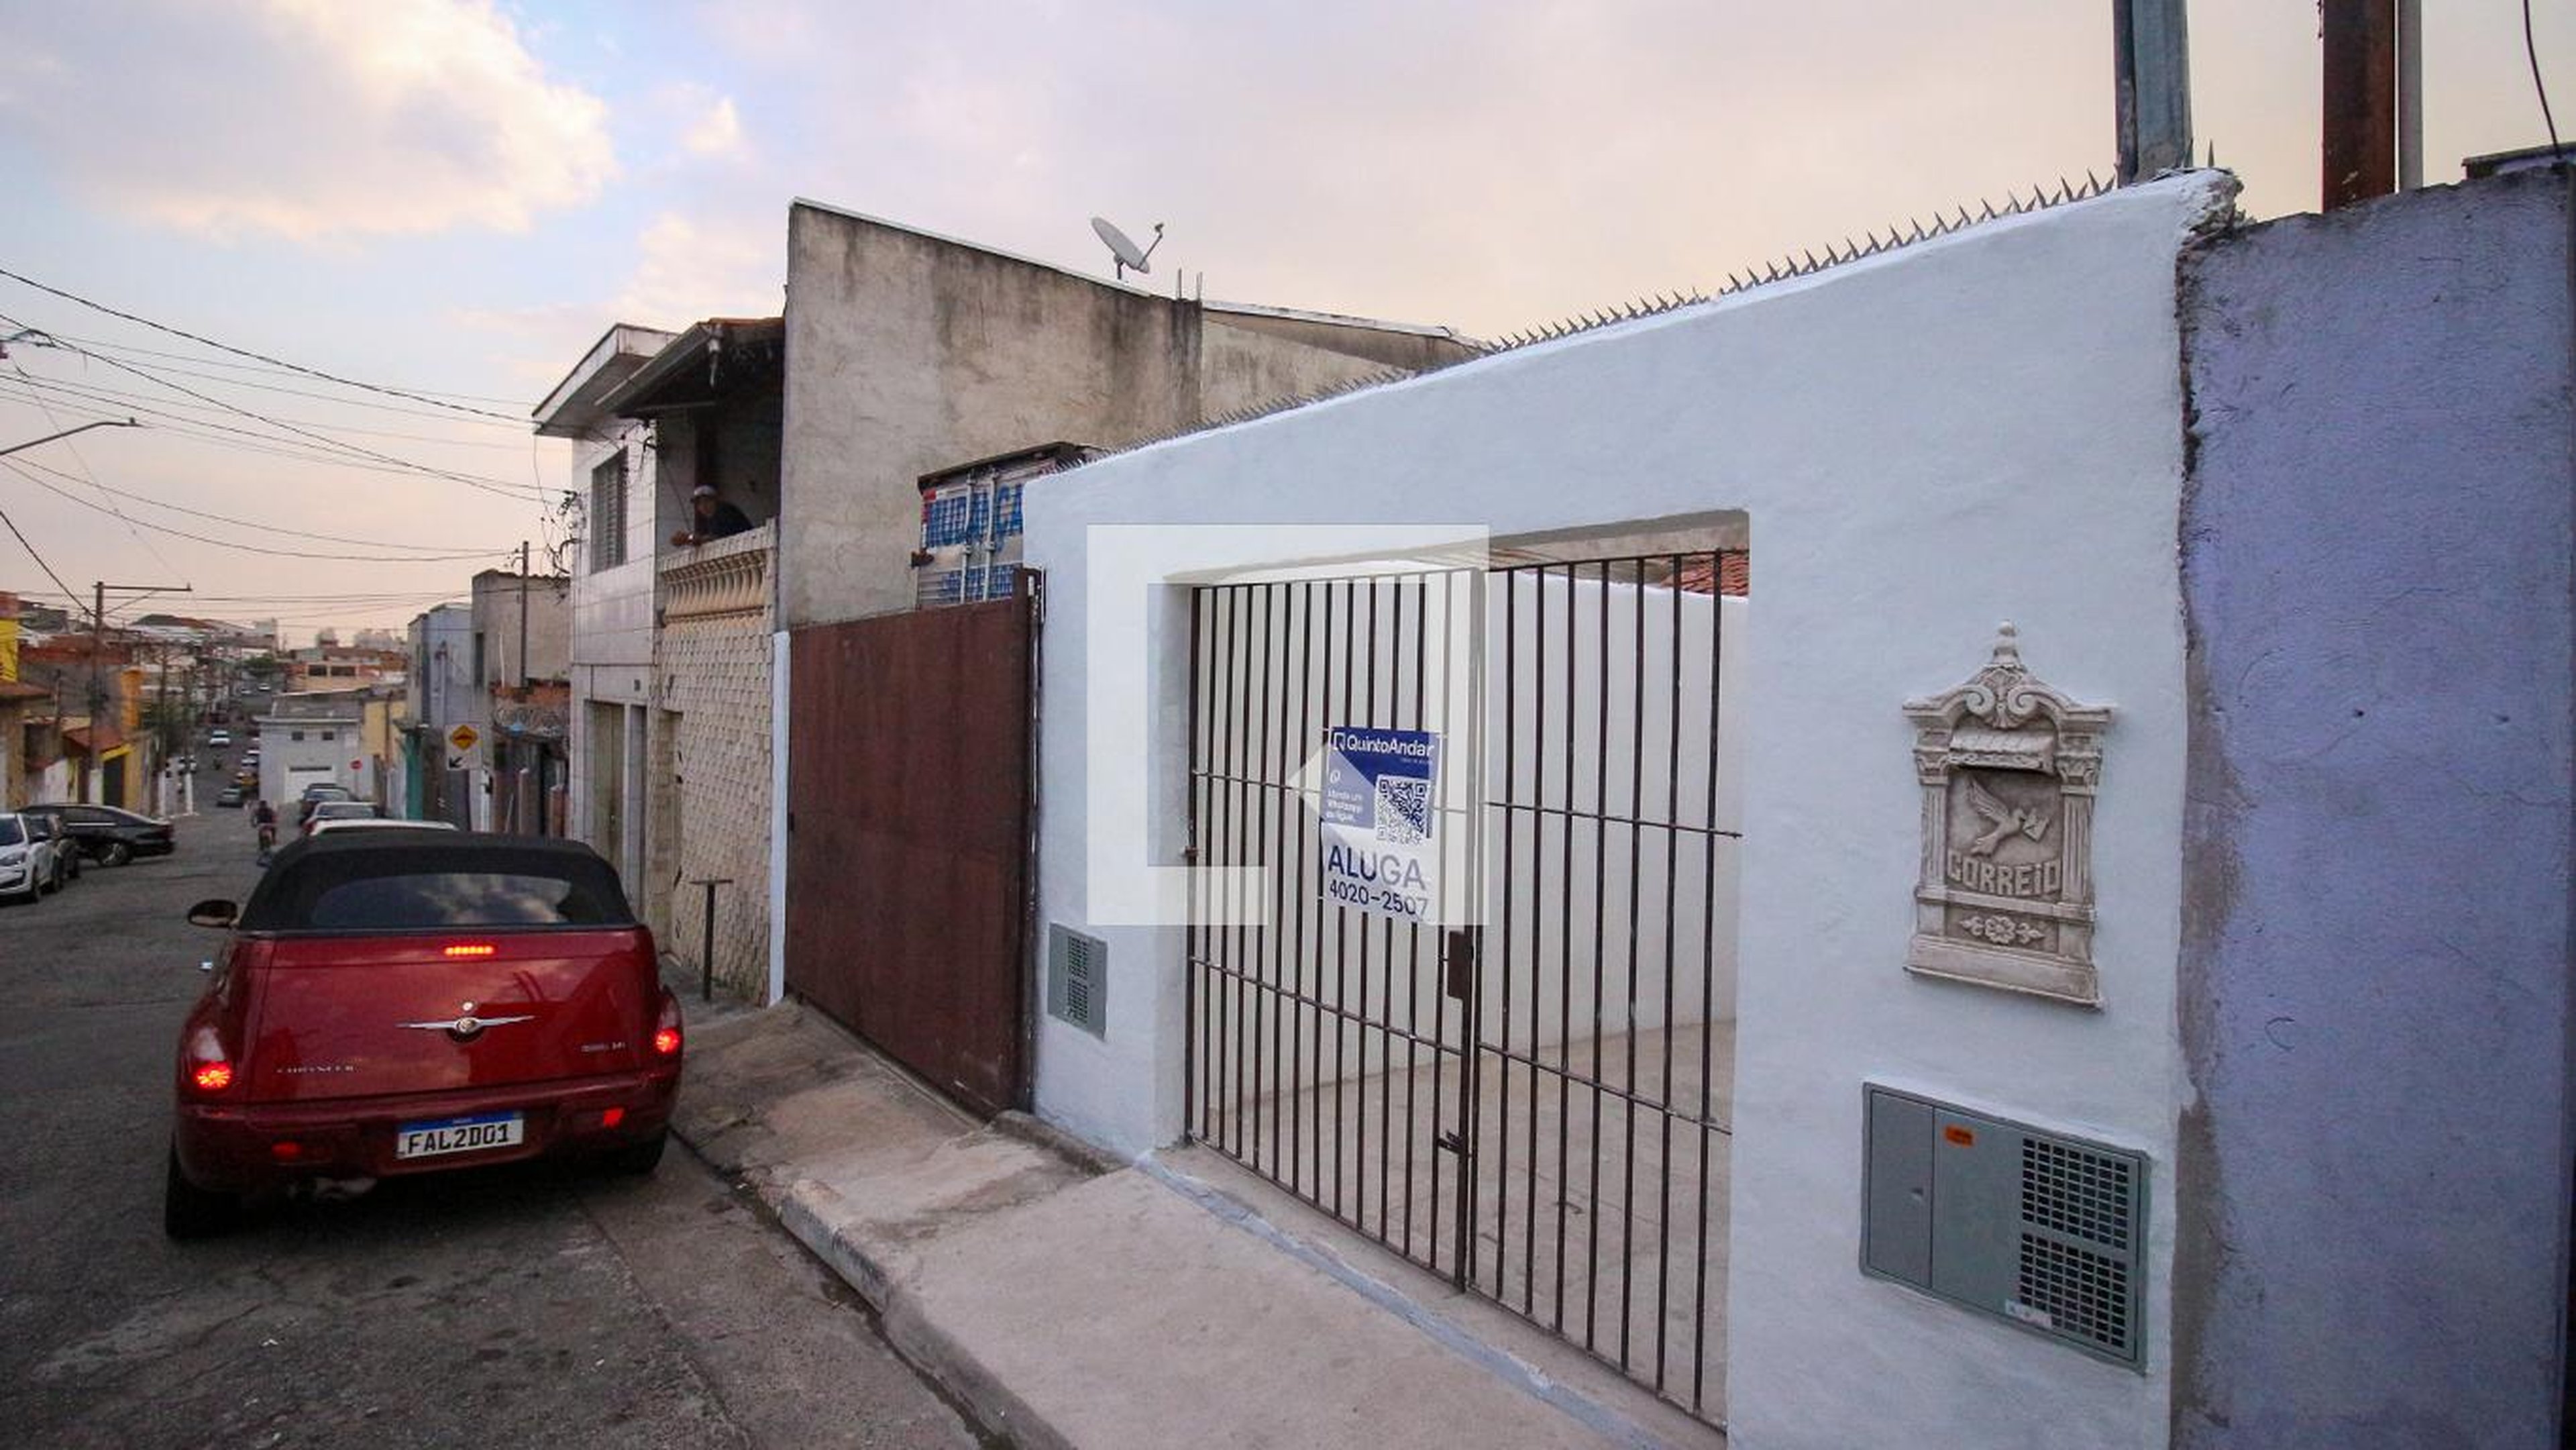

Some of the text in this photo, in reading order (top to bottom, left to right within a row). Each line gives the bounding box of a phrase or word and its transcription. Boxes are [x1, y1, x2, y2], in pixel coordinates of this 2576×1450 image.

[1347, 734, 1434, 756] QuintoAndar
[1328, 845, 1426, 890] ALUGA
[1330, 879, 1428, 916] 4020-2507
[407, 1124, 508, 1154] FAL2D01
